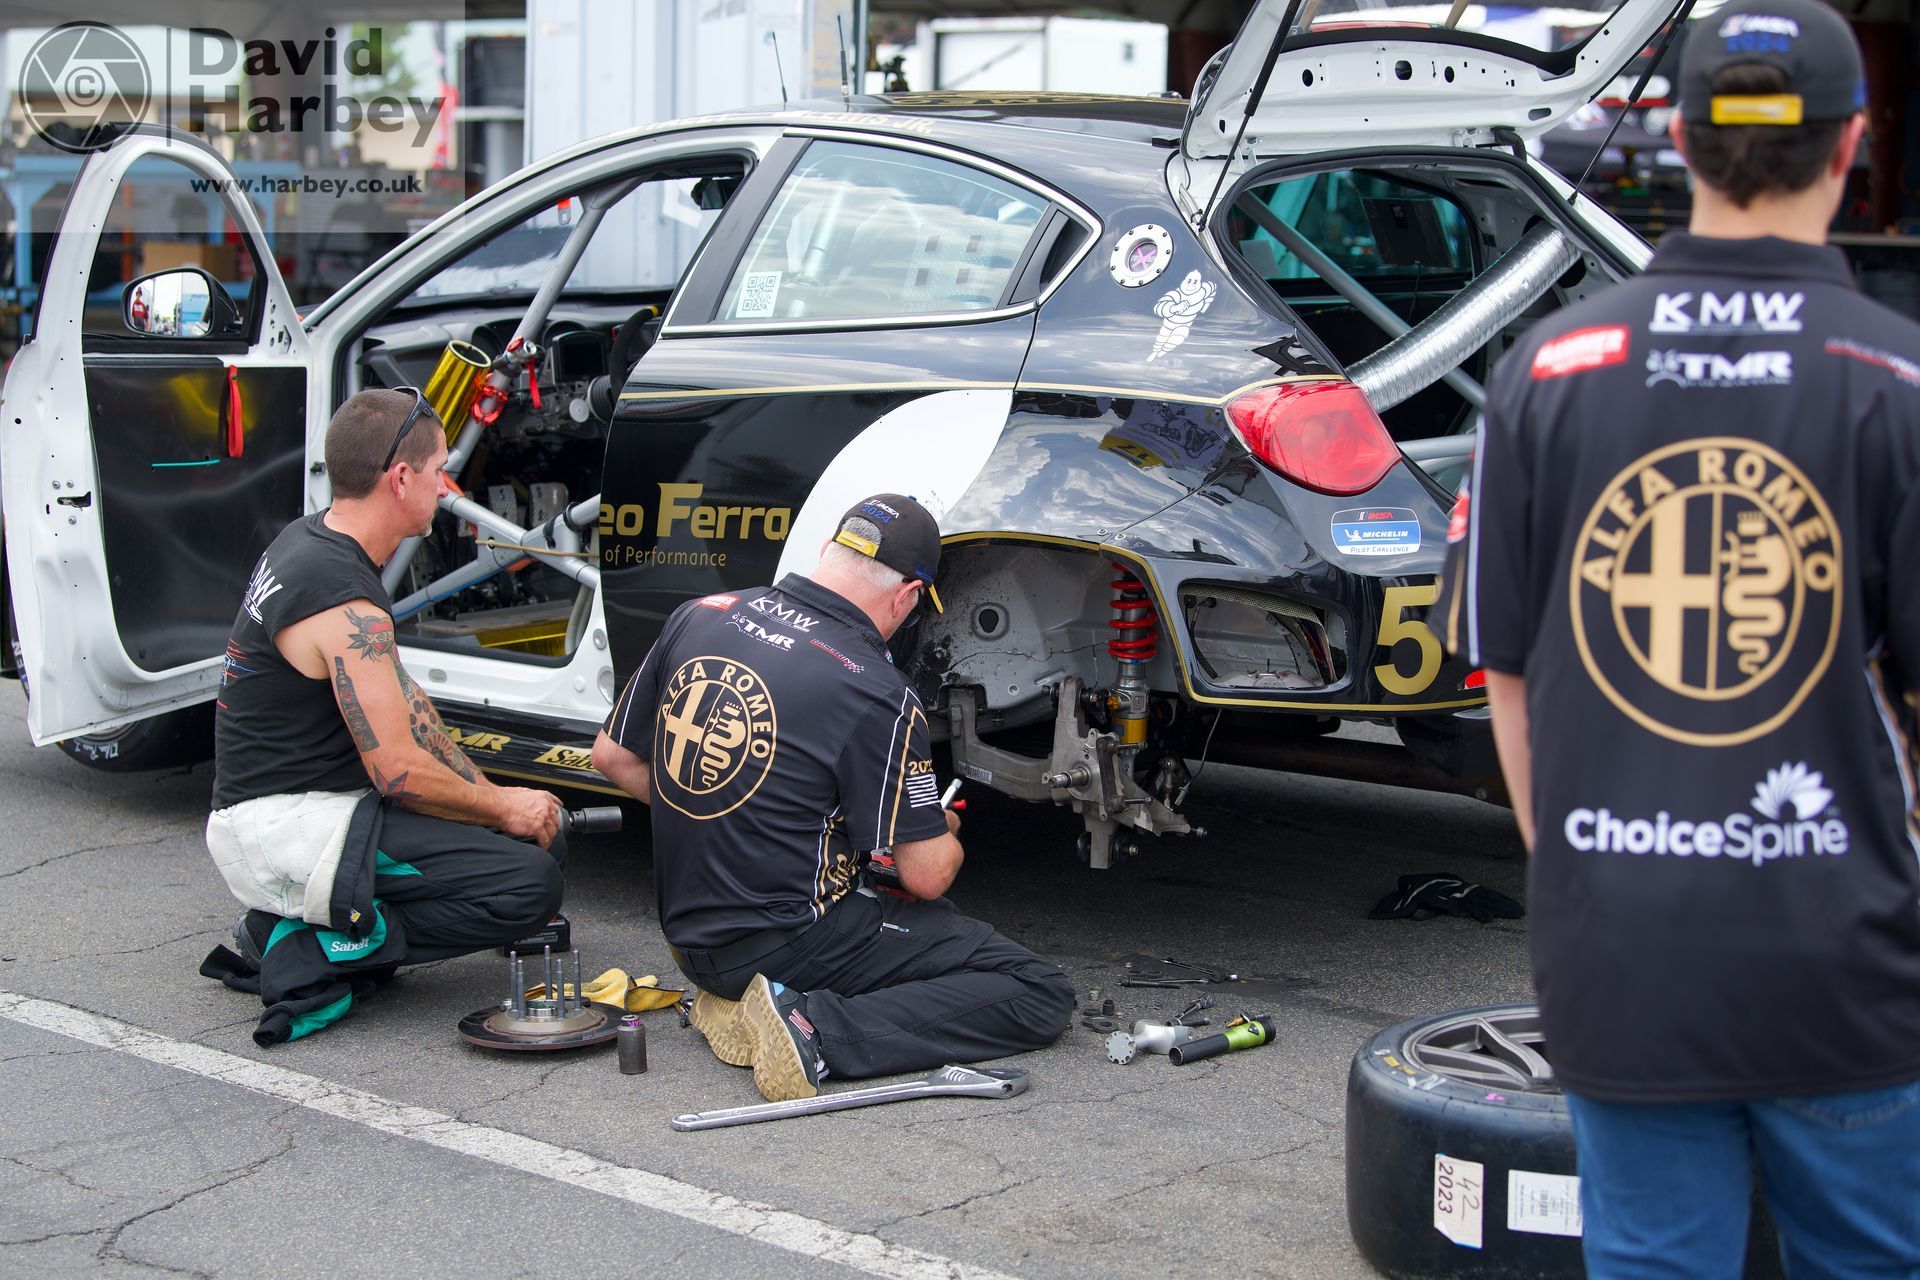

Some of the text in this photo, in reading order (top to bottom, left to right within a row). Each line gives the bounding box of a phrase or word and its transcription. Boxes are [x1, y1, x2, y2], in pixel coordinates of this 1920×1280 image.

[1651, 291, 1804, 328] KMW
[1677, 351, 1793, 380] TMR
[860, 505, 892, 523] 2024
[1367, 511, 1393, 520] IMSA
[1581, 448, 1836, 592] ALFA ROMEO
[1362, 530, 1409, 538] MICHELIN
[605, 544, 726, 567] of Performance
[750, 596, 820, 632] KMW
[742, 618, 796, 650] TMR
[662, 661, 772, 759] ALFA ROMEO
[446, 726, 511, 751] MR
[1564, 807, 1849, 867] ChoiceSpine
[330, 936, 370, 953] Sabelt
[1437, 1161, 1454, 1214] 2023
[1455, 1176, 1480, 1222] 42
